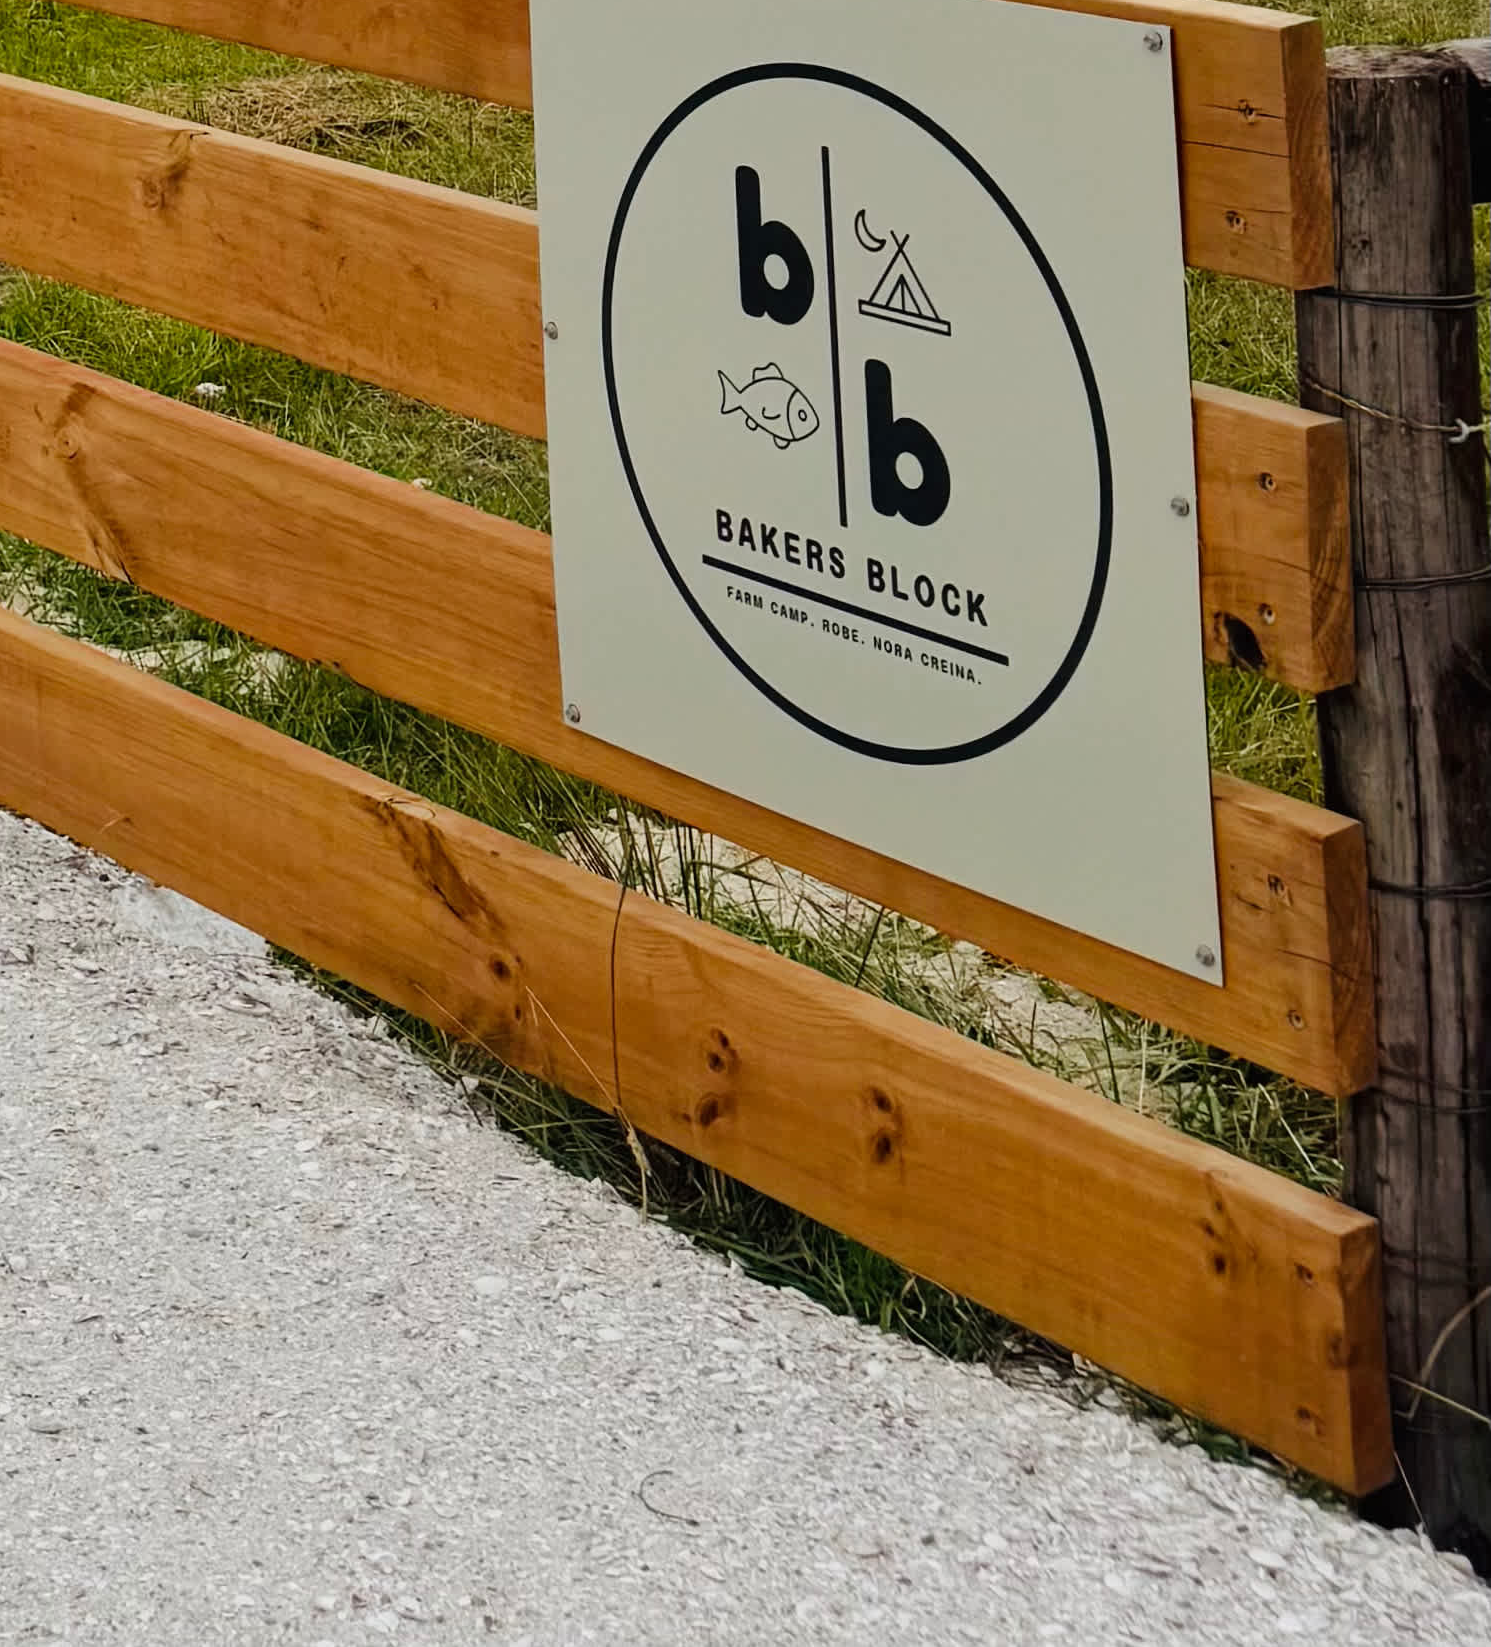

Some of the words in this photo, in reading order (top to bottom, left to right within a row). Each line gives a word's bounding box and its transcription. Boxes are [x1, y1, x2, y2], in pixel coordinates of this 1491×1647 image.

[734, 164, 815, 326] b
[864, 358, 951, 527] b
[715, 508, 846, 579] BAKERS
[866, 557, 988, 627] BLOCK
[726, 585, 764, 610] FARM
[770, 600, 815, 628] CAMP.
[822, 618, 866, 645] ROBE.
[873, 635, 913, 663] NORA
[920, 652, 982, 686] CREINA.
